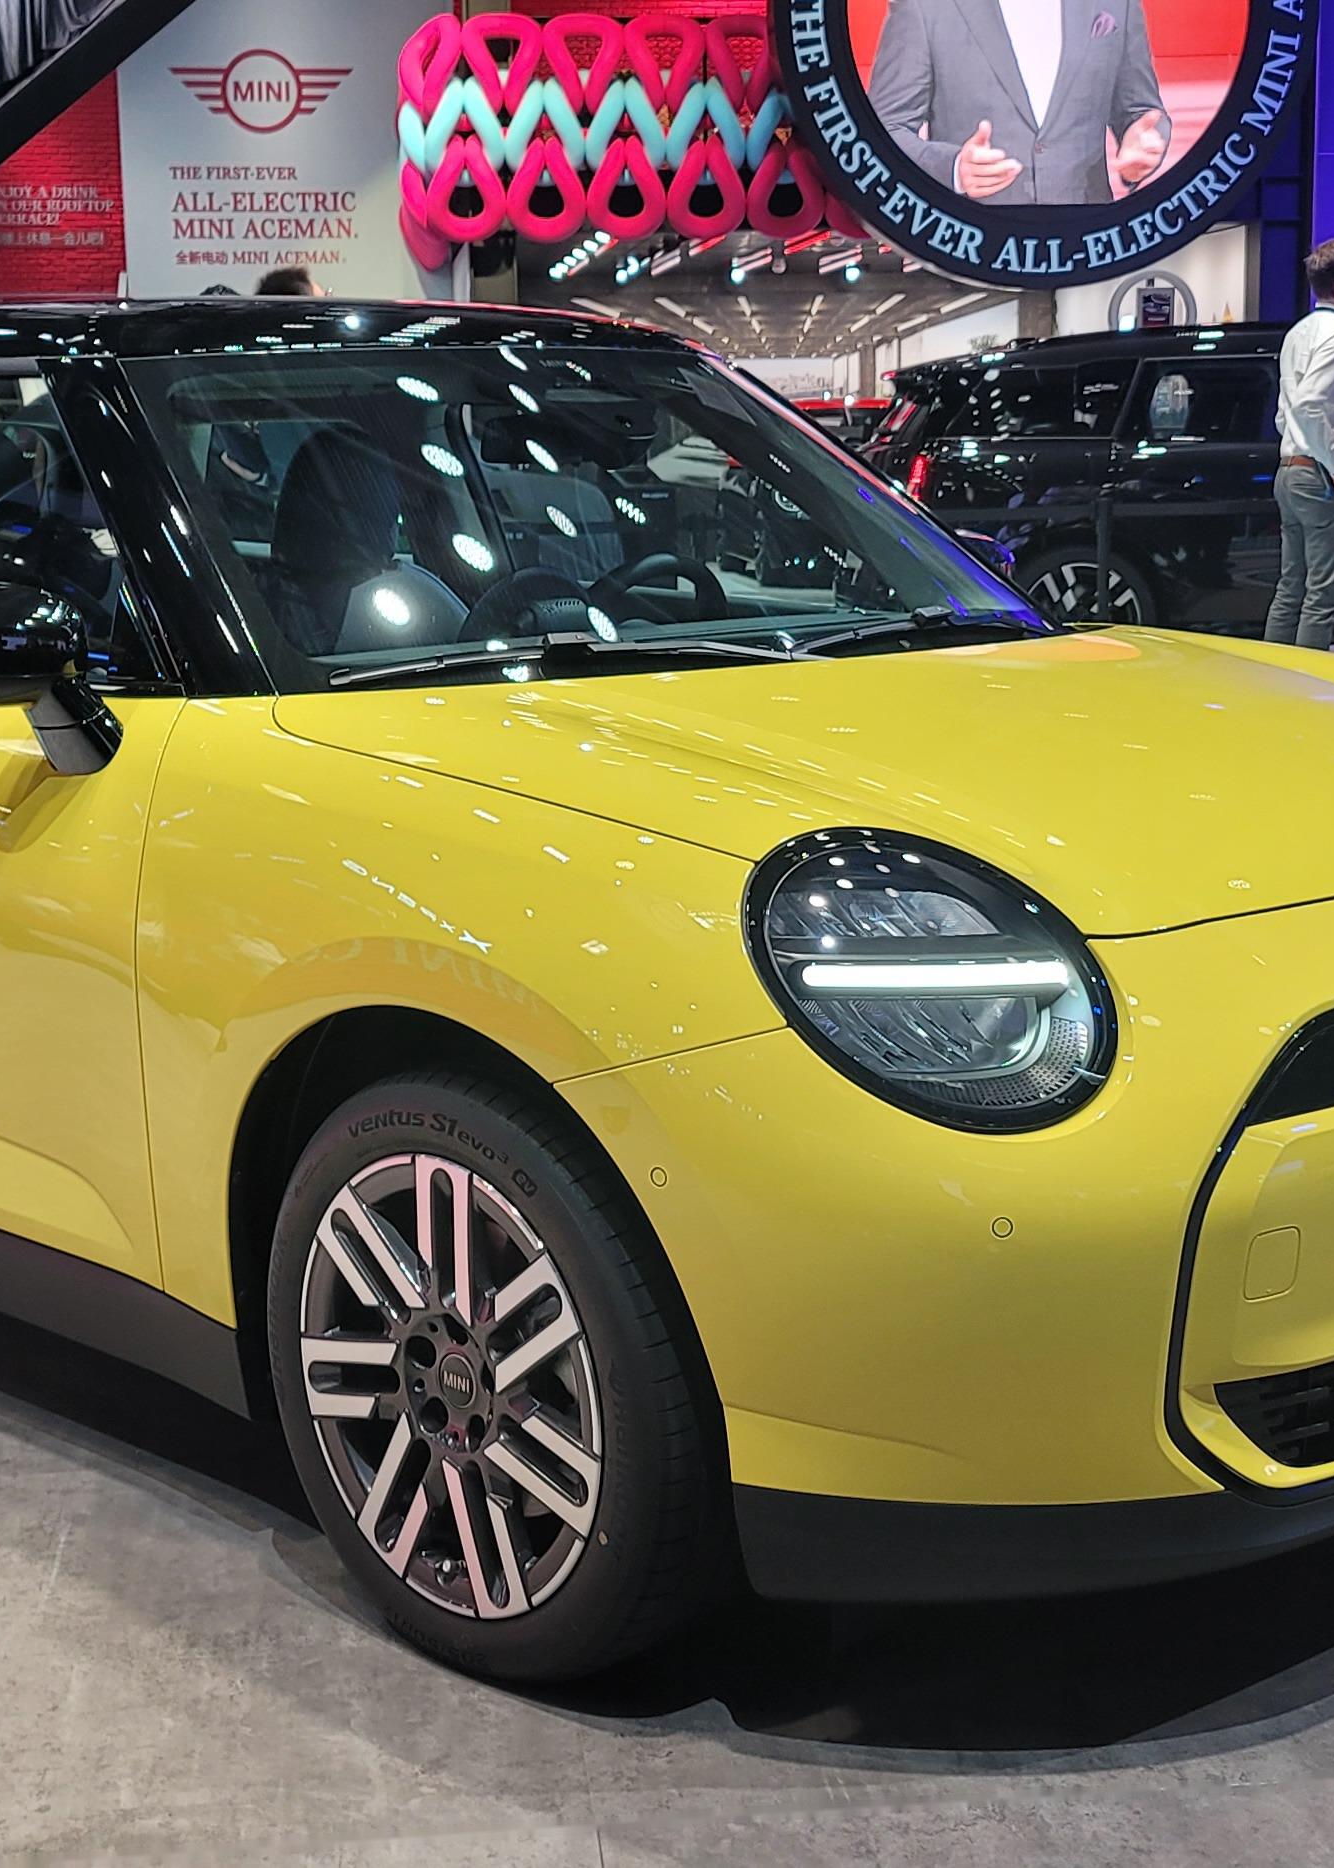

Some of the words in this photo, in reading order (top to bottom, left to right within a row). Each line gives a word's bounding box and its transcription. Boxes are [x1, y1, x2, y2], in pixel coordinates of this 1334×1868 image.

[233, 81, 290, 102] MINI
[804, 75, 984, 264] FIRST-EVER
[991, 132, 1257, 274] ALL-ELECTRIC
[1240, 29, 1301, 136] MINI
[169, 166, 202, 181] THE
[206, 166, 298, 181] FIRST-EVER
[37, 186, 49, 199] A
[51, 186, 99, 199] DRINK
[171, 191, 357, 213] ALL-ELECTRIC
[11, 200, 44, 212] OUR
[46, 199, 115, 212] ROOFTOP
[172, 218, 235, 240] MINI
[243, 218, 359, 240] ACEMAN.
[175, 250, 228, 266] 全新电动
[232, 251, 269, 265] MINI
[443, 1370, 470, 1393] MINI
